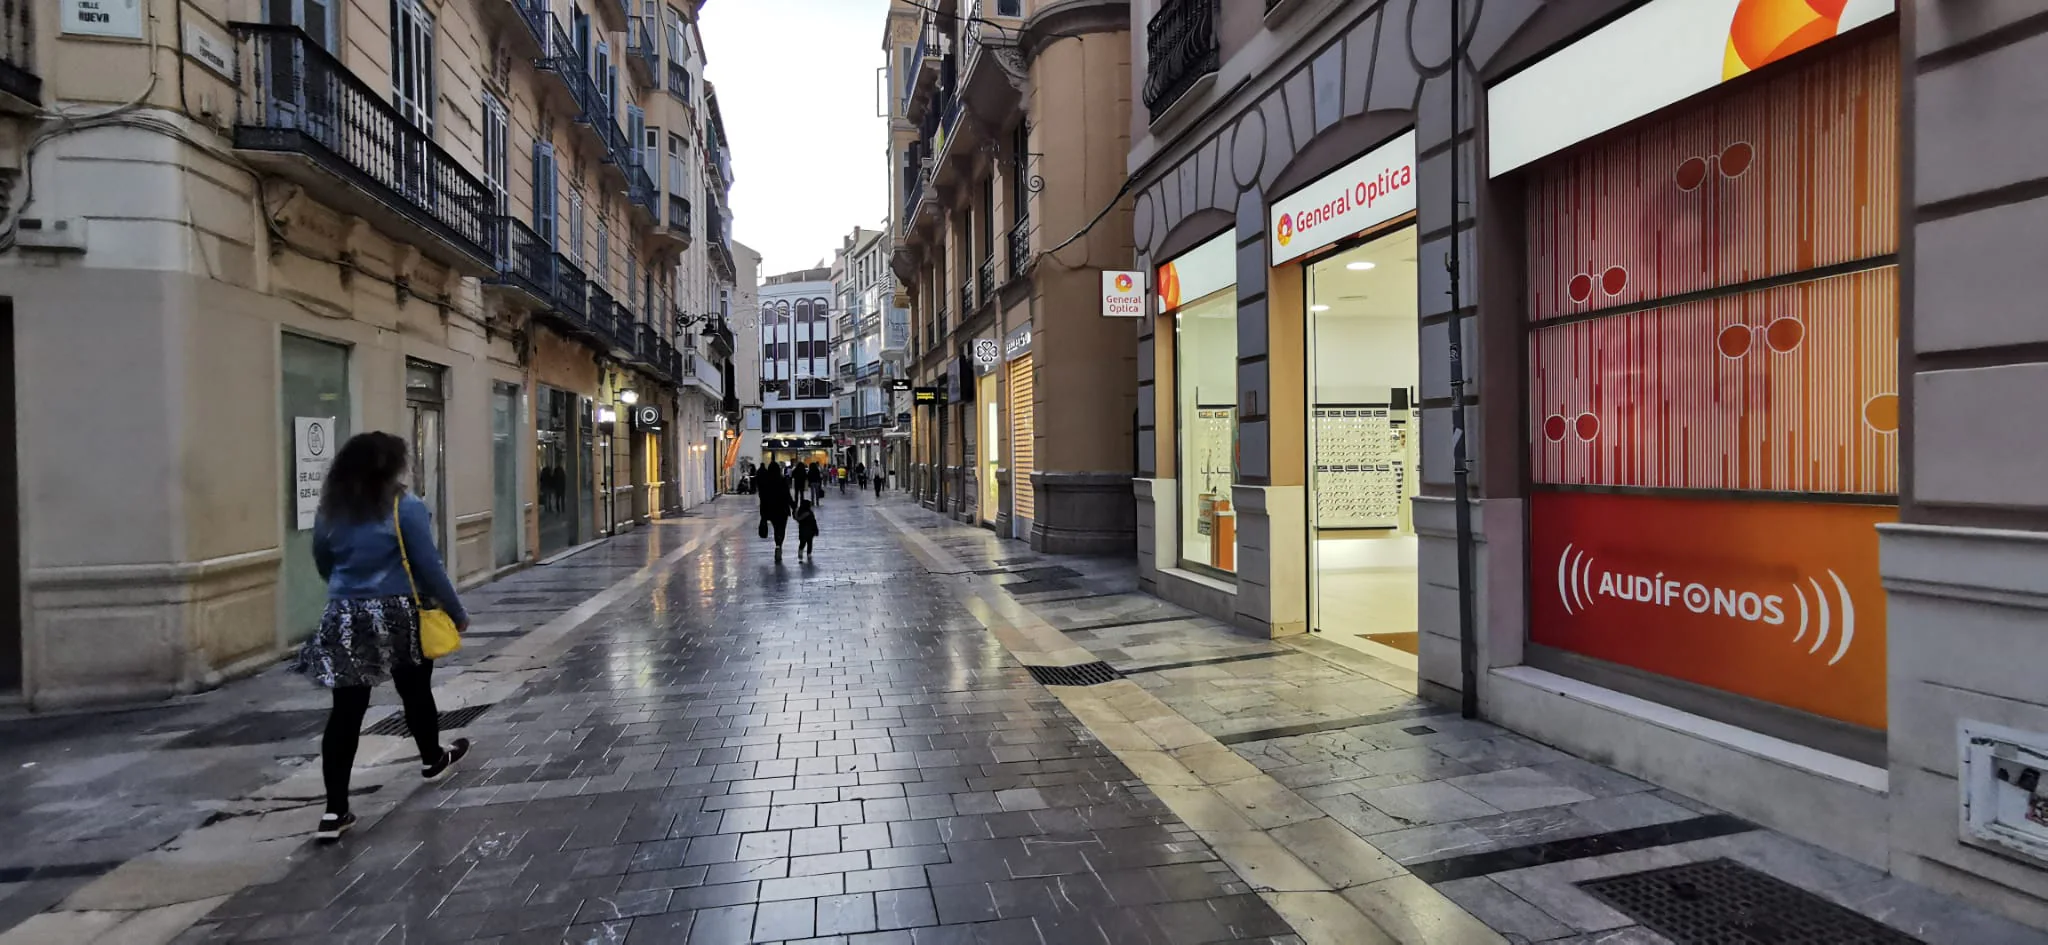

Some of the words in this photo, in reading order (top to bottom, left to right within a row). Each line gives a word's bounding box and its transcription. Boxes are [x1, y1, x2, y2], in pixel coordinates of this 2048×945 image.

[1296, 188, 1351, 233] General
[1355, 165, 1411, 208] Optica
[1106, 295, 1142, 304] General
[1109, 304, 1139, 314] Optica
[1598, 572, 1784, 625] AUDÍFONOS
